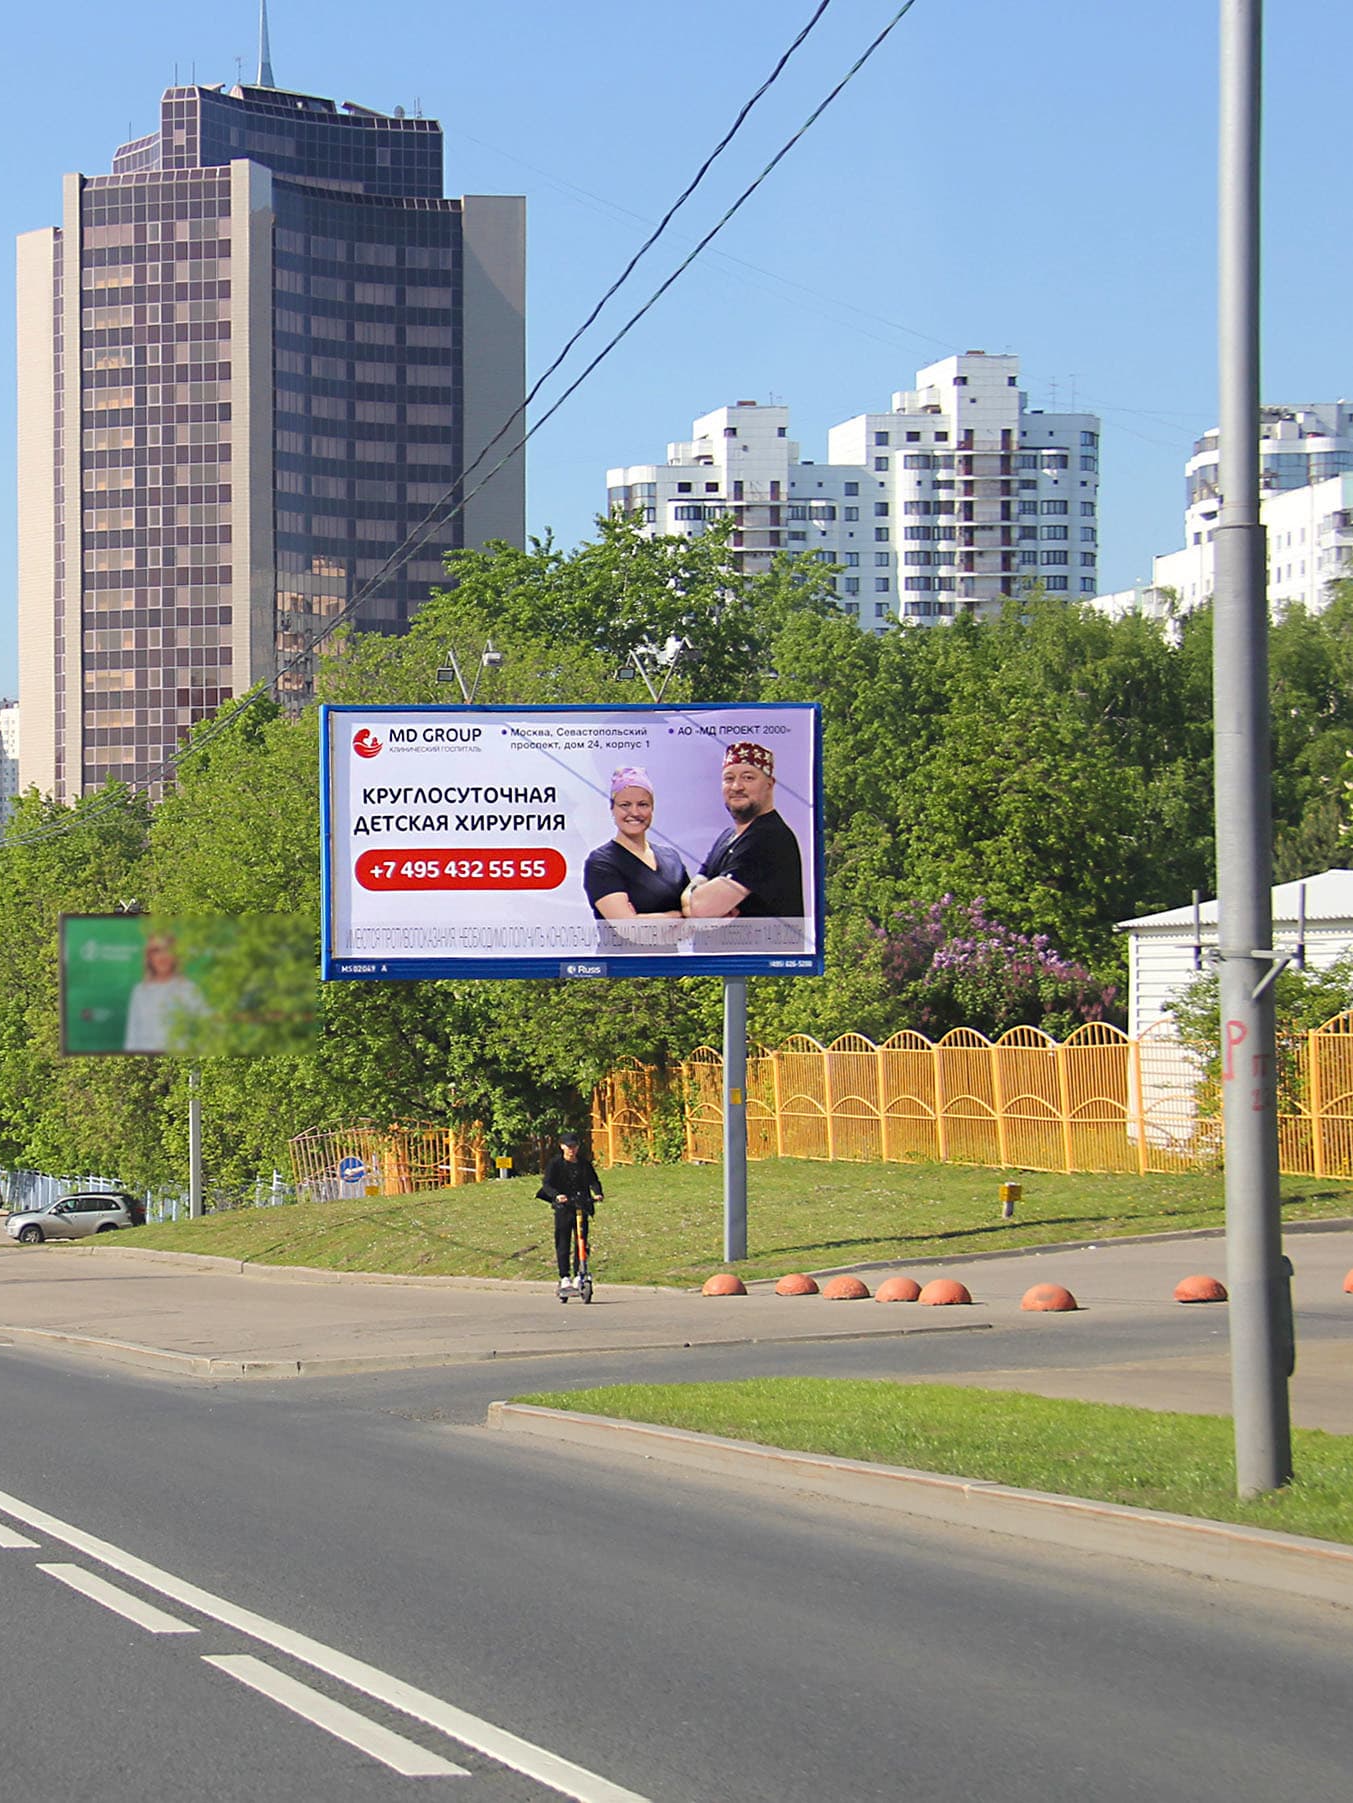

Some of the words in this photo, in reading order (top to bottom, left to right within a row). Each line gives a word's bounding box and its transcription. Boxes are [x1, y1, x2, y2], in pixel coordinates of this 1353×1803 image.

[389, 728, 417, 742] MD
[422, 728, 482, 742] GROUP
[511, 728, 553, 738] Москва,
[556, 726, 648, 737] Севастопольский
[678, 726, 692, 735] АО
[719, 725, 761, 735] ПРОЕКТ
[441, 745, 482, 753] ГОСПИТАЛЬ
[510, 740, 561, 751] проспект,
[563, 740, 585, 750] дом
[587, 740, 603, 750] 24,
[605, 740, 644, 750] корпус
[362, 786, 557, 804] КРУГЛОСУТОЧНАЯ
[354, 815, 448, 836] ДЕТСКАЯ
[455, 814, 566, 832] ХИРУРГИЯ
[369, 861, 396, 878] +7
[400, 861, 440, 878] 495
[444, 860, 484, 878] 432
[488, 860, 515, 878] 55
[520, 860, 546, 877] 55
[578, 965, 601, 974] Russ
